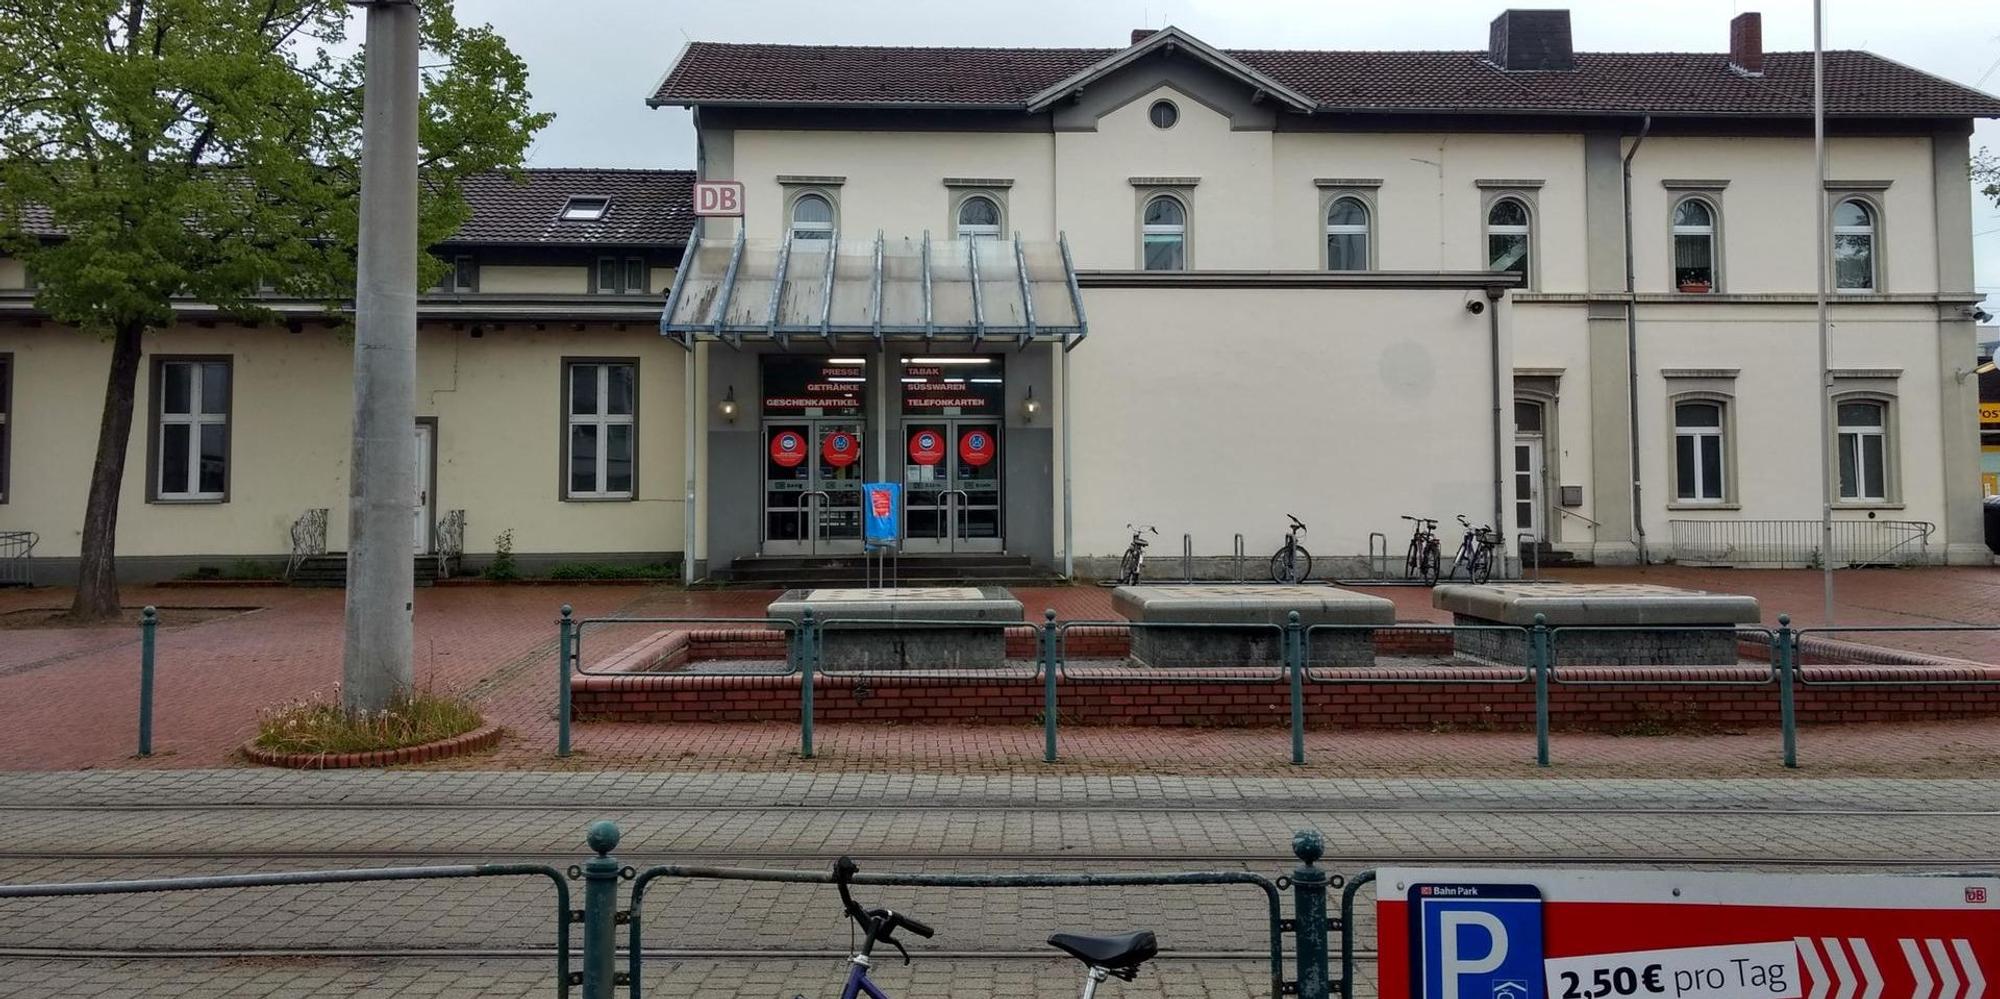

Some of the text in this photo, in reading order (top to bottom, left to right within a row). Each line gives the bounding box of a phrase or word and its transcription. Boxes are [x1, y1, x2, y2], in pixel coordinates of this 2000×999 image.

[701, 187, 737, 211] DB
[822, 368, 860, 376] PRESSE
[807, 383, 860, 391] GETRÄNKE
[907, 382, 966, 391] SÜSSWAREN
[907, 398, 985, 406] TELEFONKARTEN
[1433, 887, 1456, 895] Bahn
[1457, 887, 1478, 896] Park
[1440, 911, 1508, 999] P
[1674, 967, 1725, 997] pro
[1729, 958, 1788, 992] Tag
